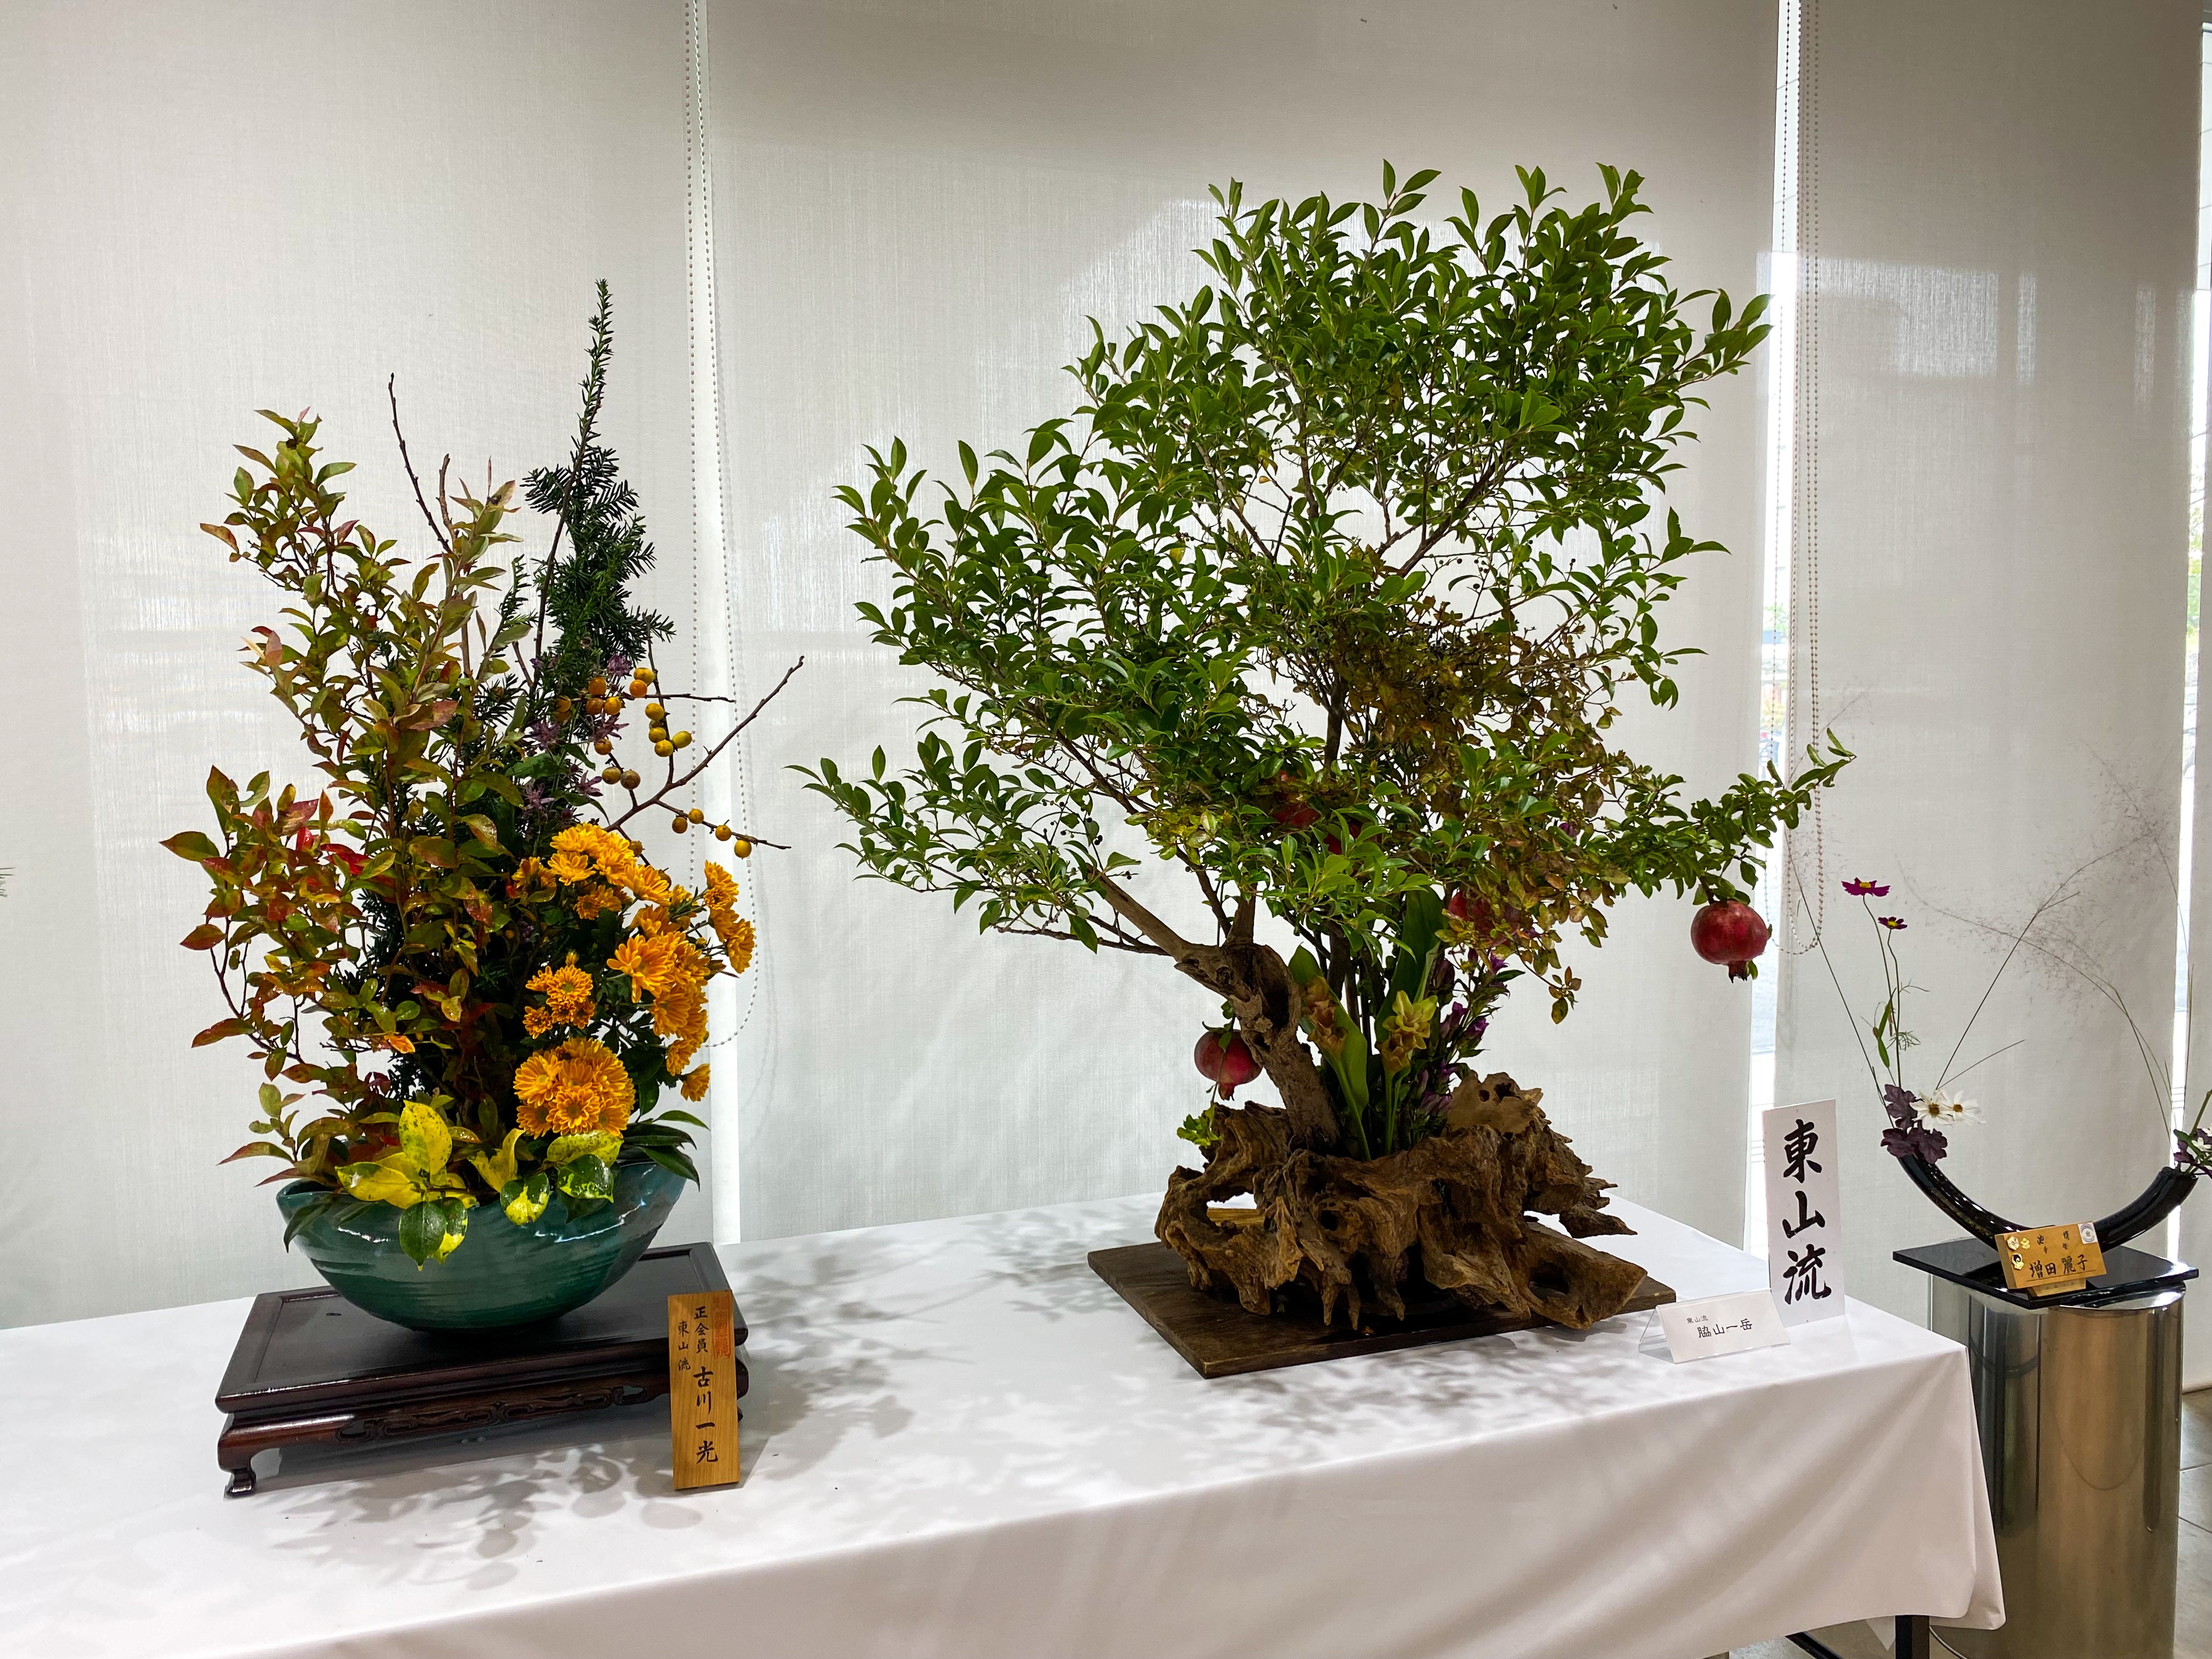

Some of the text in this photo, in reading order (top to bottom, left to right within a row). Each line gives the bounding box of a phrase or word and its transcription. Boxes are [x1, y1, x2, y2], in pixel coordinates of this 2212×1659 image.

[1782, 1119, 1832, 1305] 東山流
[678, 1321, 691, 1371] 東山流
[1697, 1318, 1753, 1338] 脇山一岳
[693, 1306, 719, 1464] 正会員 古川一光
